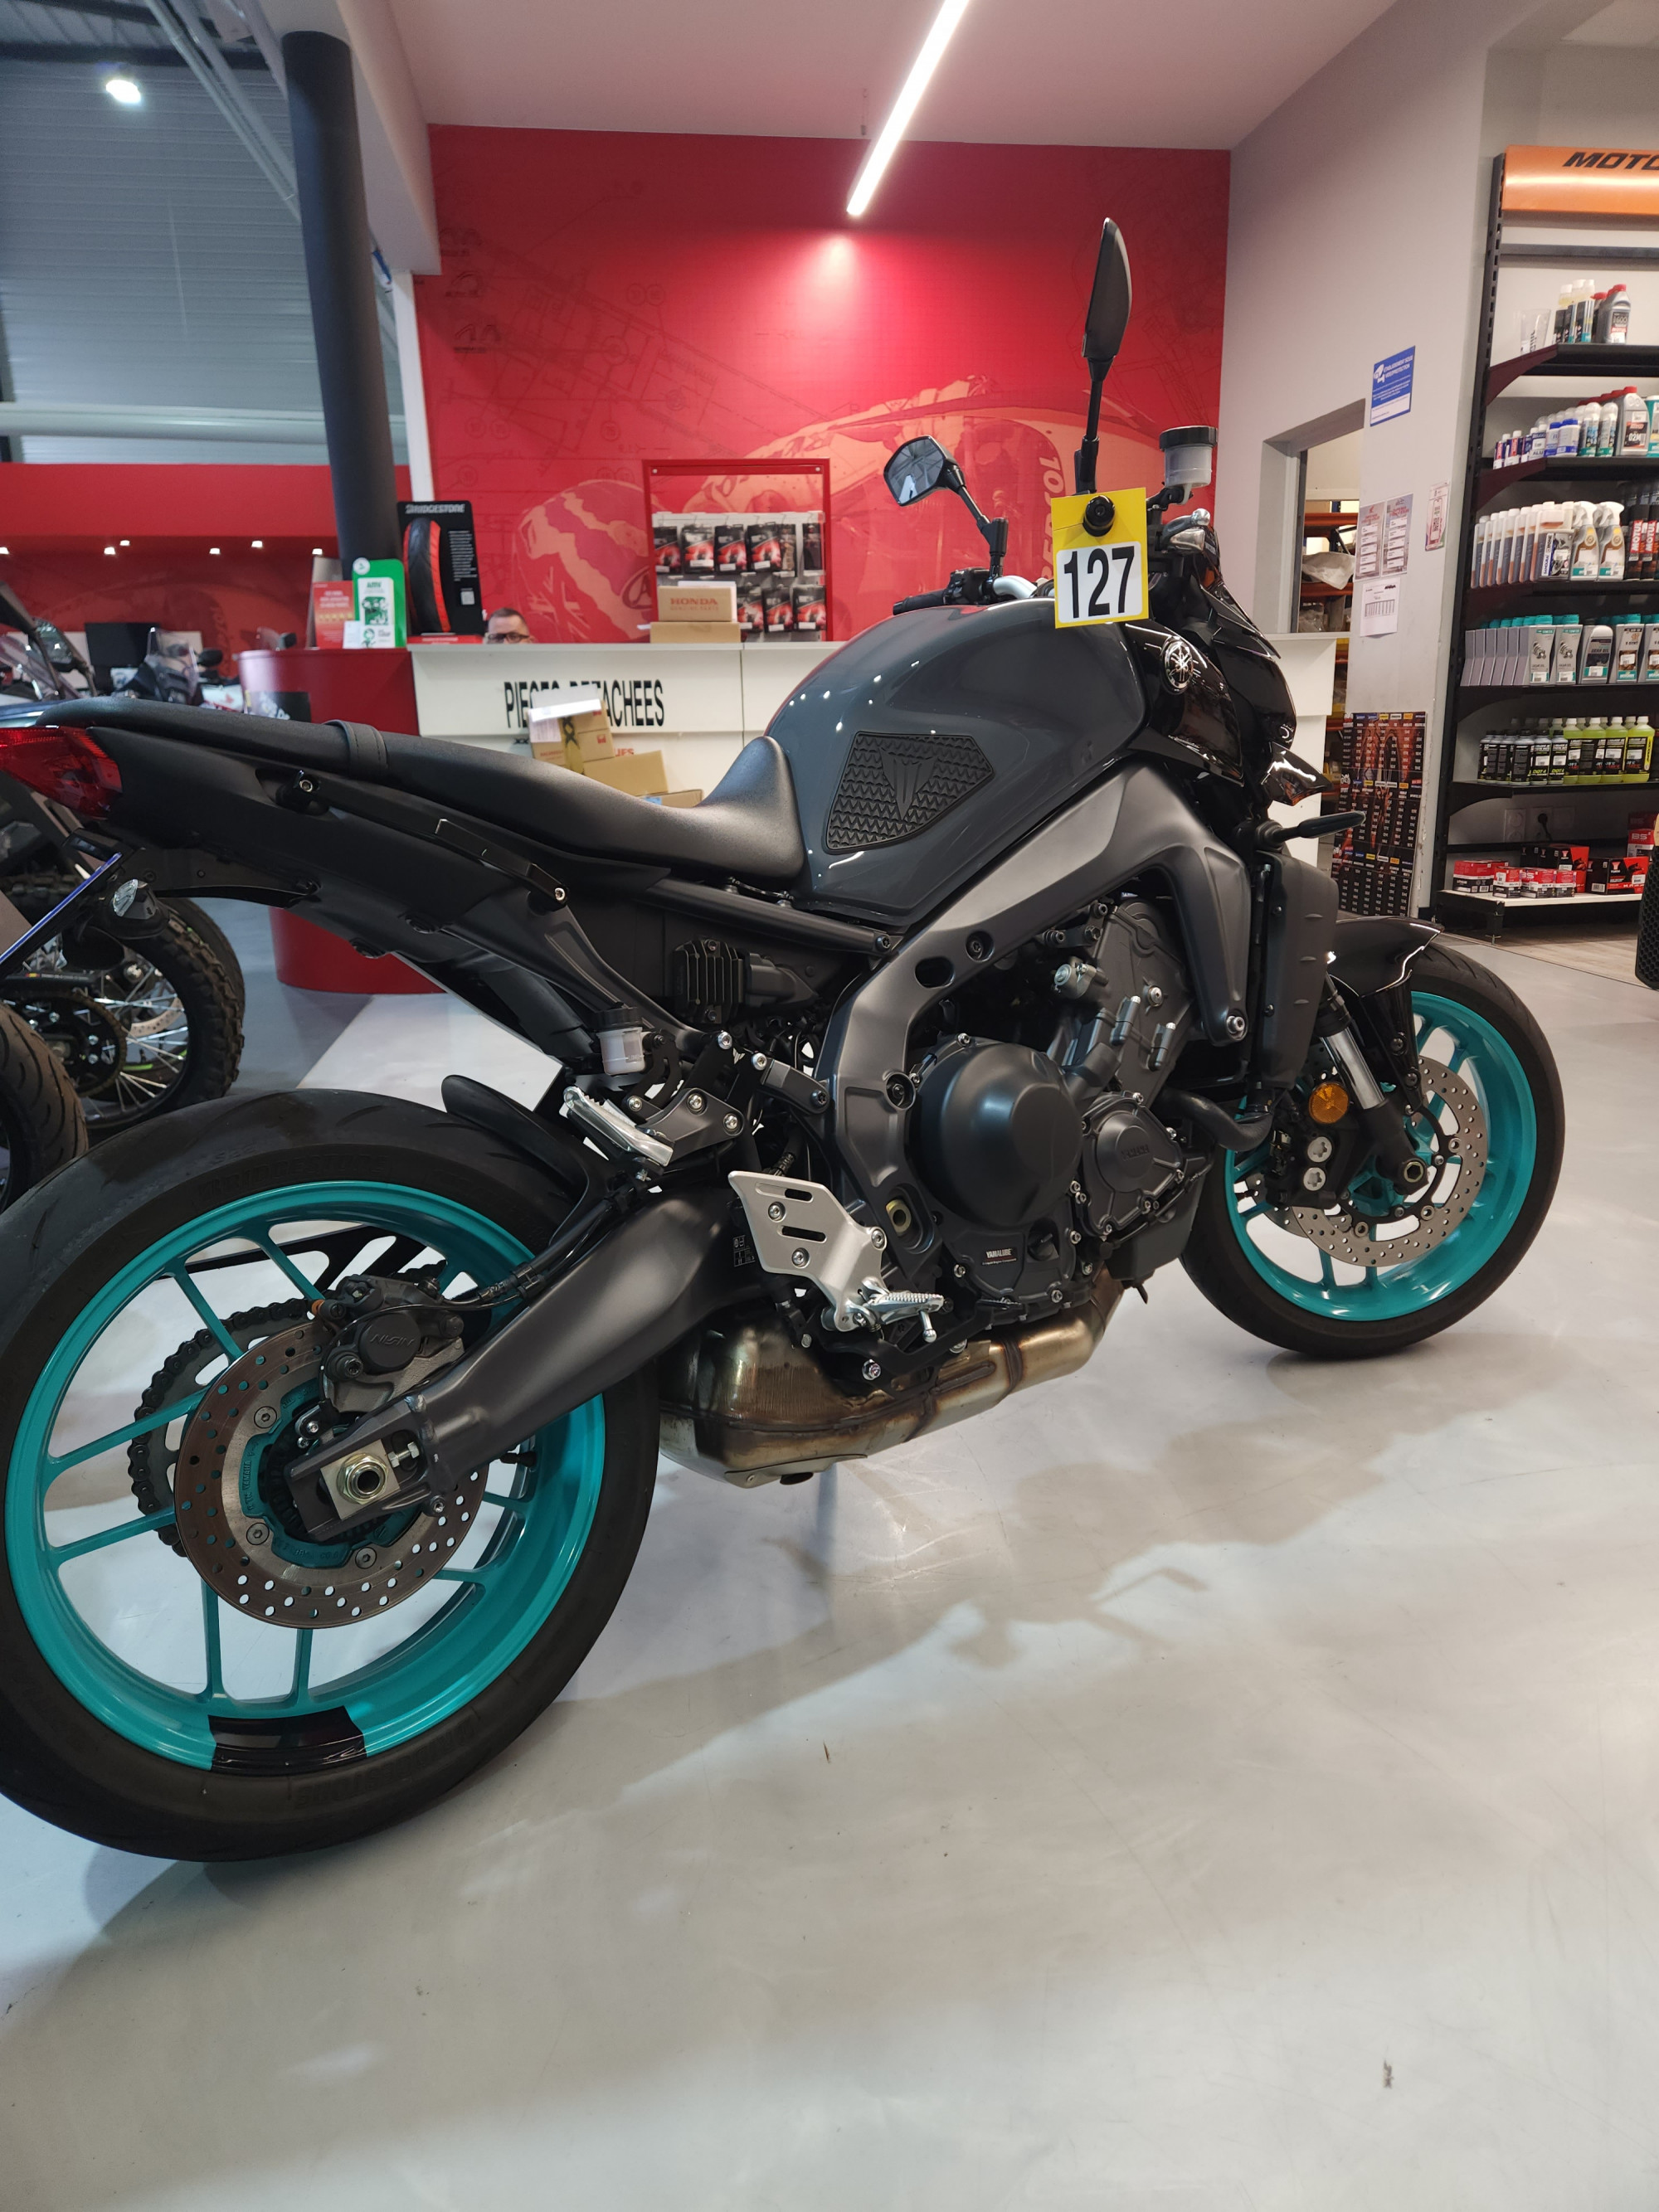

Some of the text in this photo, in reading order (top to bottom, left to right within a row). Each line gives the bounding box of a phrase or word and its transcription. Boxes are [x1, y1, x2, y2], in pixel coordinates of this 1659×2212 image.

[406, 503, 465, 515] BRIDGESTONE
[1632, 521, 1642, 552] MOTUL
[1645, 521, 1656, 552] MOTUL
[1063, 545, 1135, 619] 127
[670, 597, 718, 605] HONDA
[504, 678, 665, 728] PIE ACHEES
[985, 1247, 1012, 1258] YAMALUBE
[369, 1333, 416, 1347] NISSIN
[241, 1460, 252, 1491] YAMAHA
